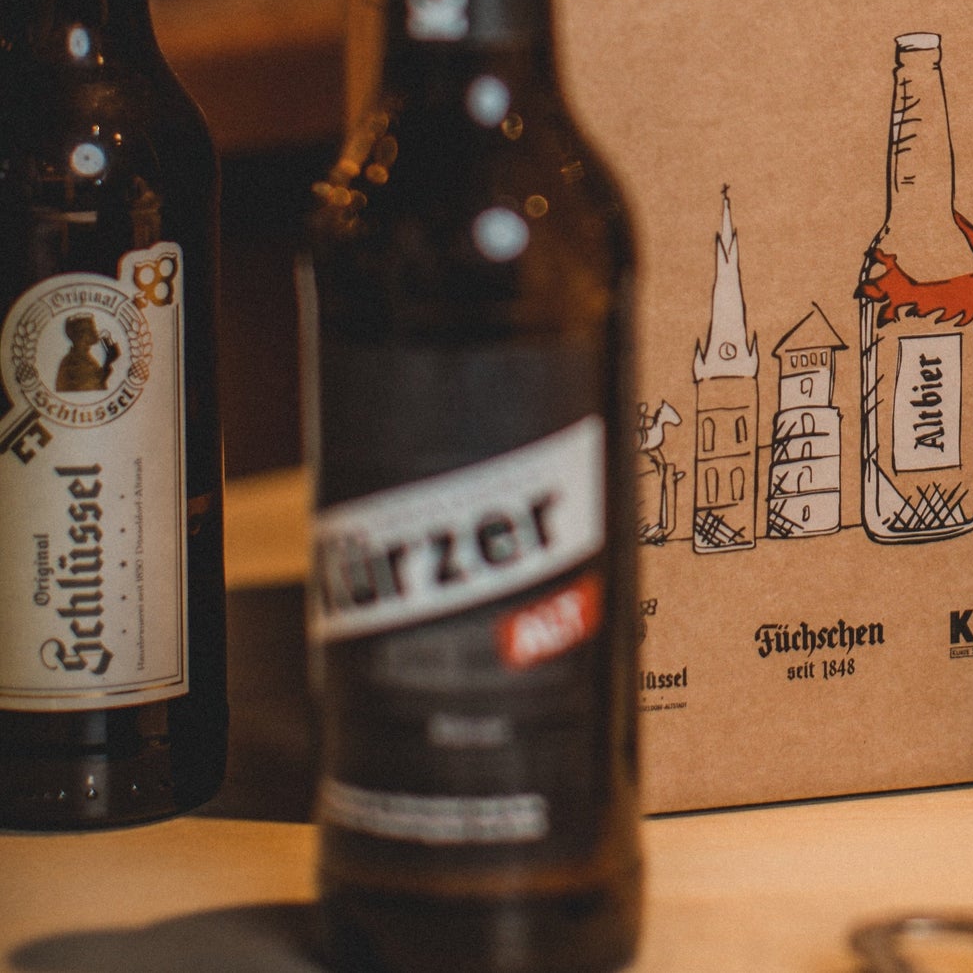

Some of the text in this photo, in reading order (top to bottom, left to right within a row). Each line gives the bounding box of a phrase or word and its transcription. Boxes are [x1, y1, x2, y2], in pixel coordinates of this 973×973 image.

[909, 353, 945, 453] Altbier
[33, 533, 54, 607] Original
[39, 462, 114, 675] Schlüssel
[754, 618, 886, 658] Füchschen
[787, 658, 855, 680] seit 1848
